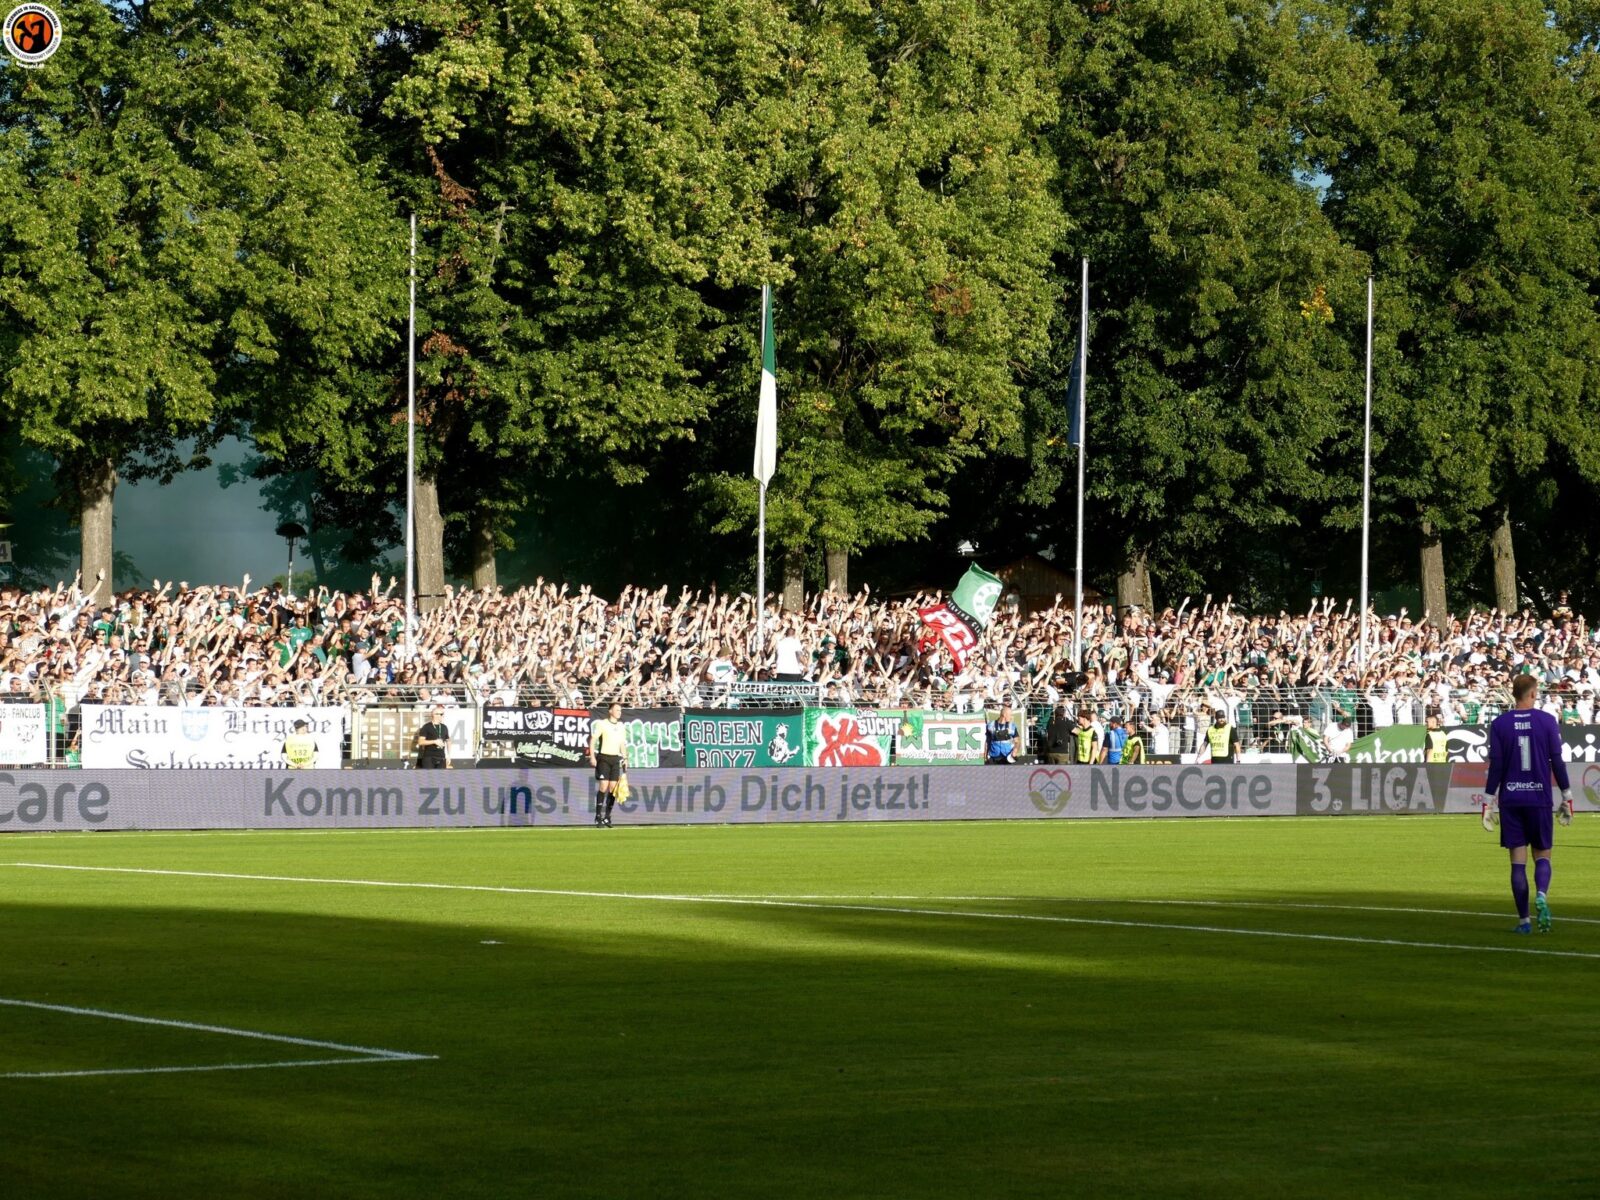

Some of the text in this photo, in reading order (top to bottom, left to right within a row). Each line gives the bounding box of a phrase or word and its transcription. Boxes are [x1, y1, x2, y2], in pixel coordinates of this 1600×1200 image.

[12, 707, 41, 719] FANCLUB
[484, 710, 523, 730] JSM
[553, 715, 586, 732] FCK
[89, 708, 168, 743] Main
[687, 719, 763, 747] GREEN
[858, 717, 901, 736] SUCHT
[553, 731, 585, 748] FWK
[695, 747, 757, 768] BOYZ
[1518, 735, 1531, 771] 1
[264, 774, 929, 820] Komm zu uns! ewirb Dich jetzt!
[1090, 766, 1272, 812] NesCare
[1351, 766, 1435, 811] LIGA
